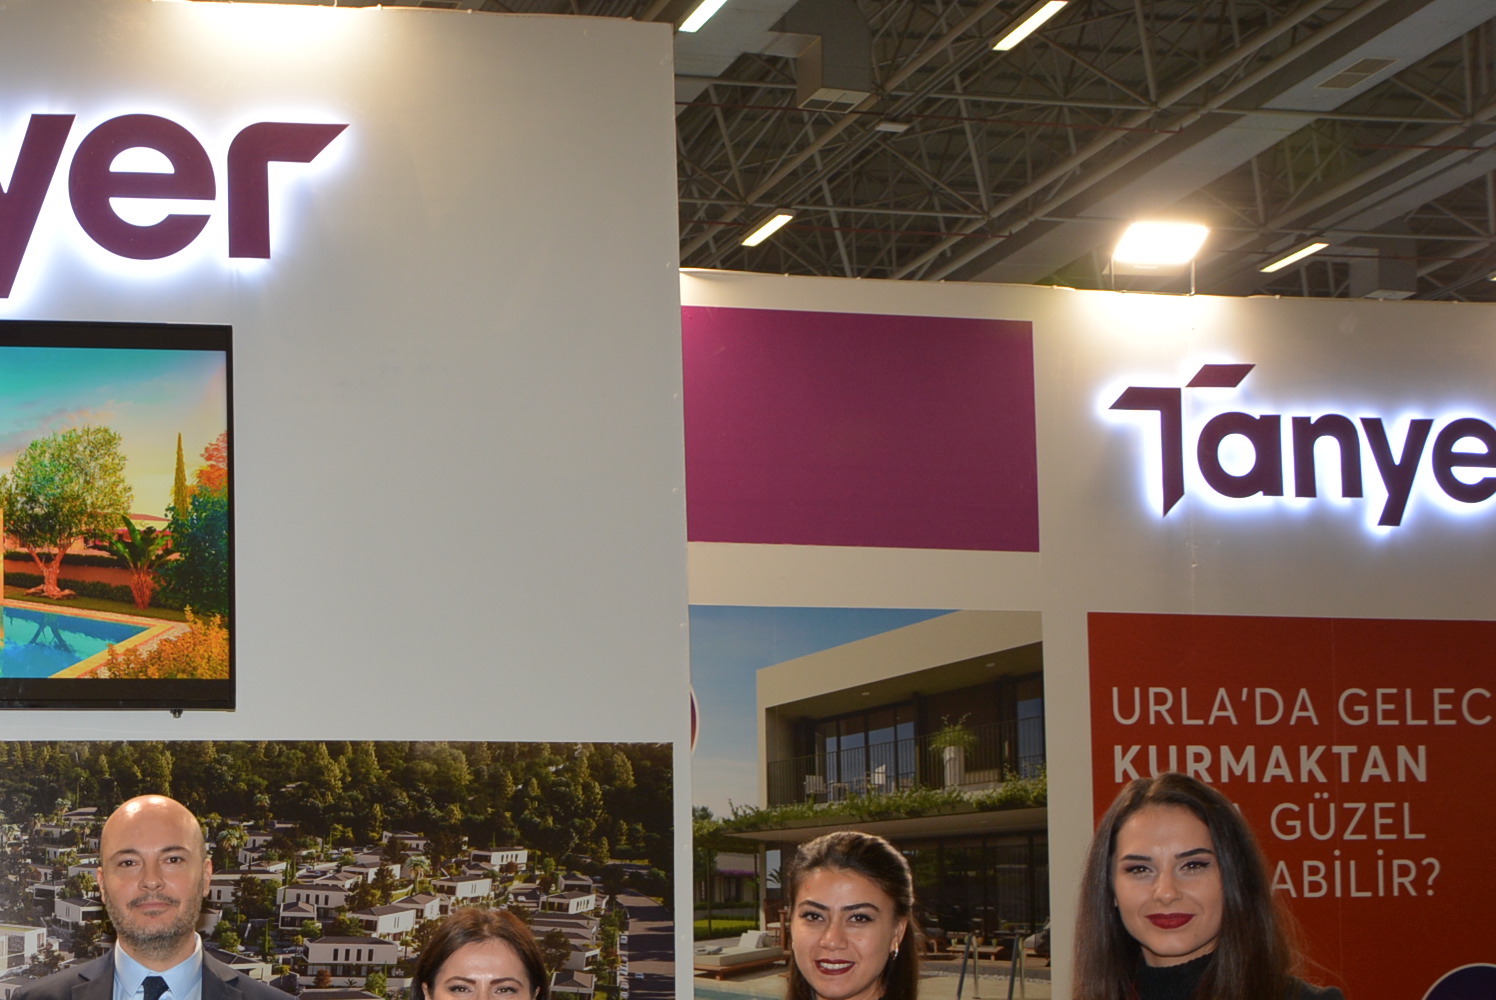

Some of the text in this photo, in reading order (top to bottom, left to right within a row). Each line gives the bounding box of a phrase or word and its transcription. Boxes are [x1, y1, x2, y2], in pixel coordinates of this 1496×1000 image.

[1112, 687, 1319, 726] URLA'DA
[1113, 745, 1427, 783] KURMAKTAN
[1270, 792, 1426, 841] GÜZEL
[1272, 849, 1441, 898] ABİLİR?
